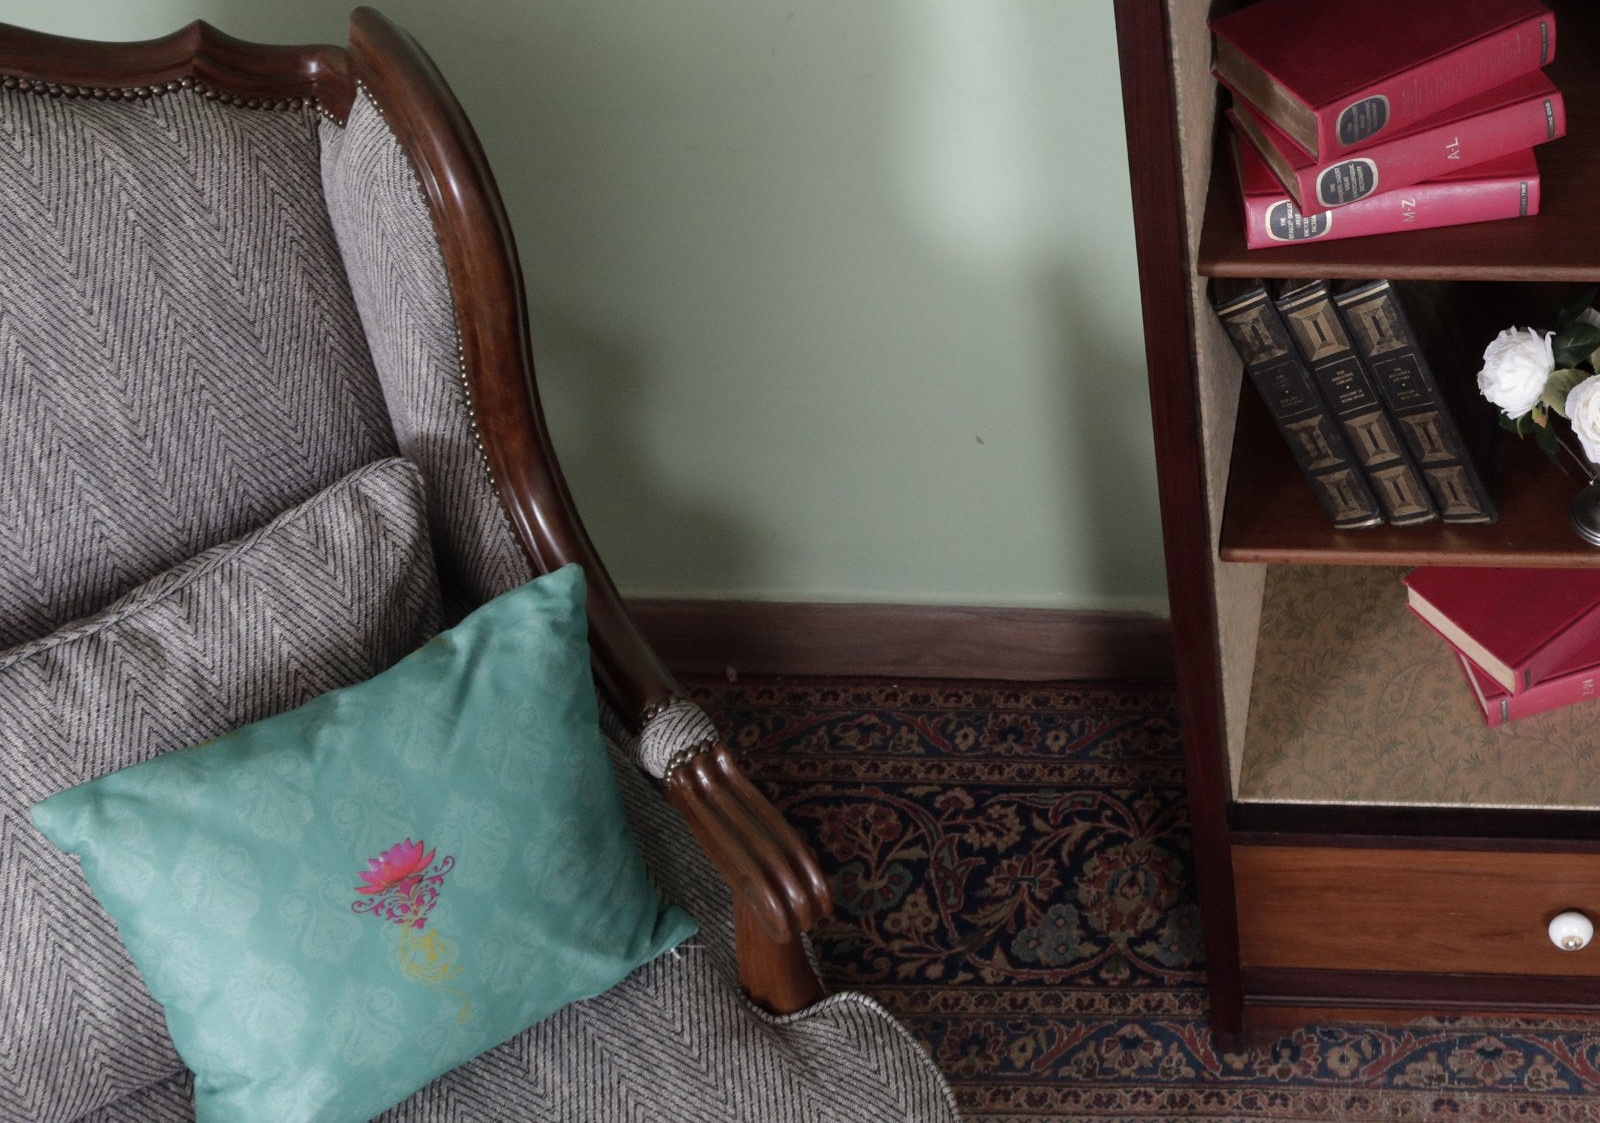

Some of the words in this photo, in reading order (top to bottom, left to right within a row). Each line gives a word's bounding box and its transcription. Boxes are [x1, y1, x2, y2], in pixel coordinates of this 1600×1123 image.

[1446, 136, 1460, 160] A-L
[1286, 202, 1294, 219] DIGEST
[1401, 197, 1416, 222] M-Z
